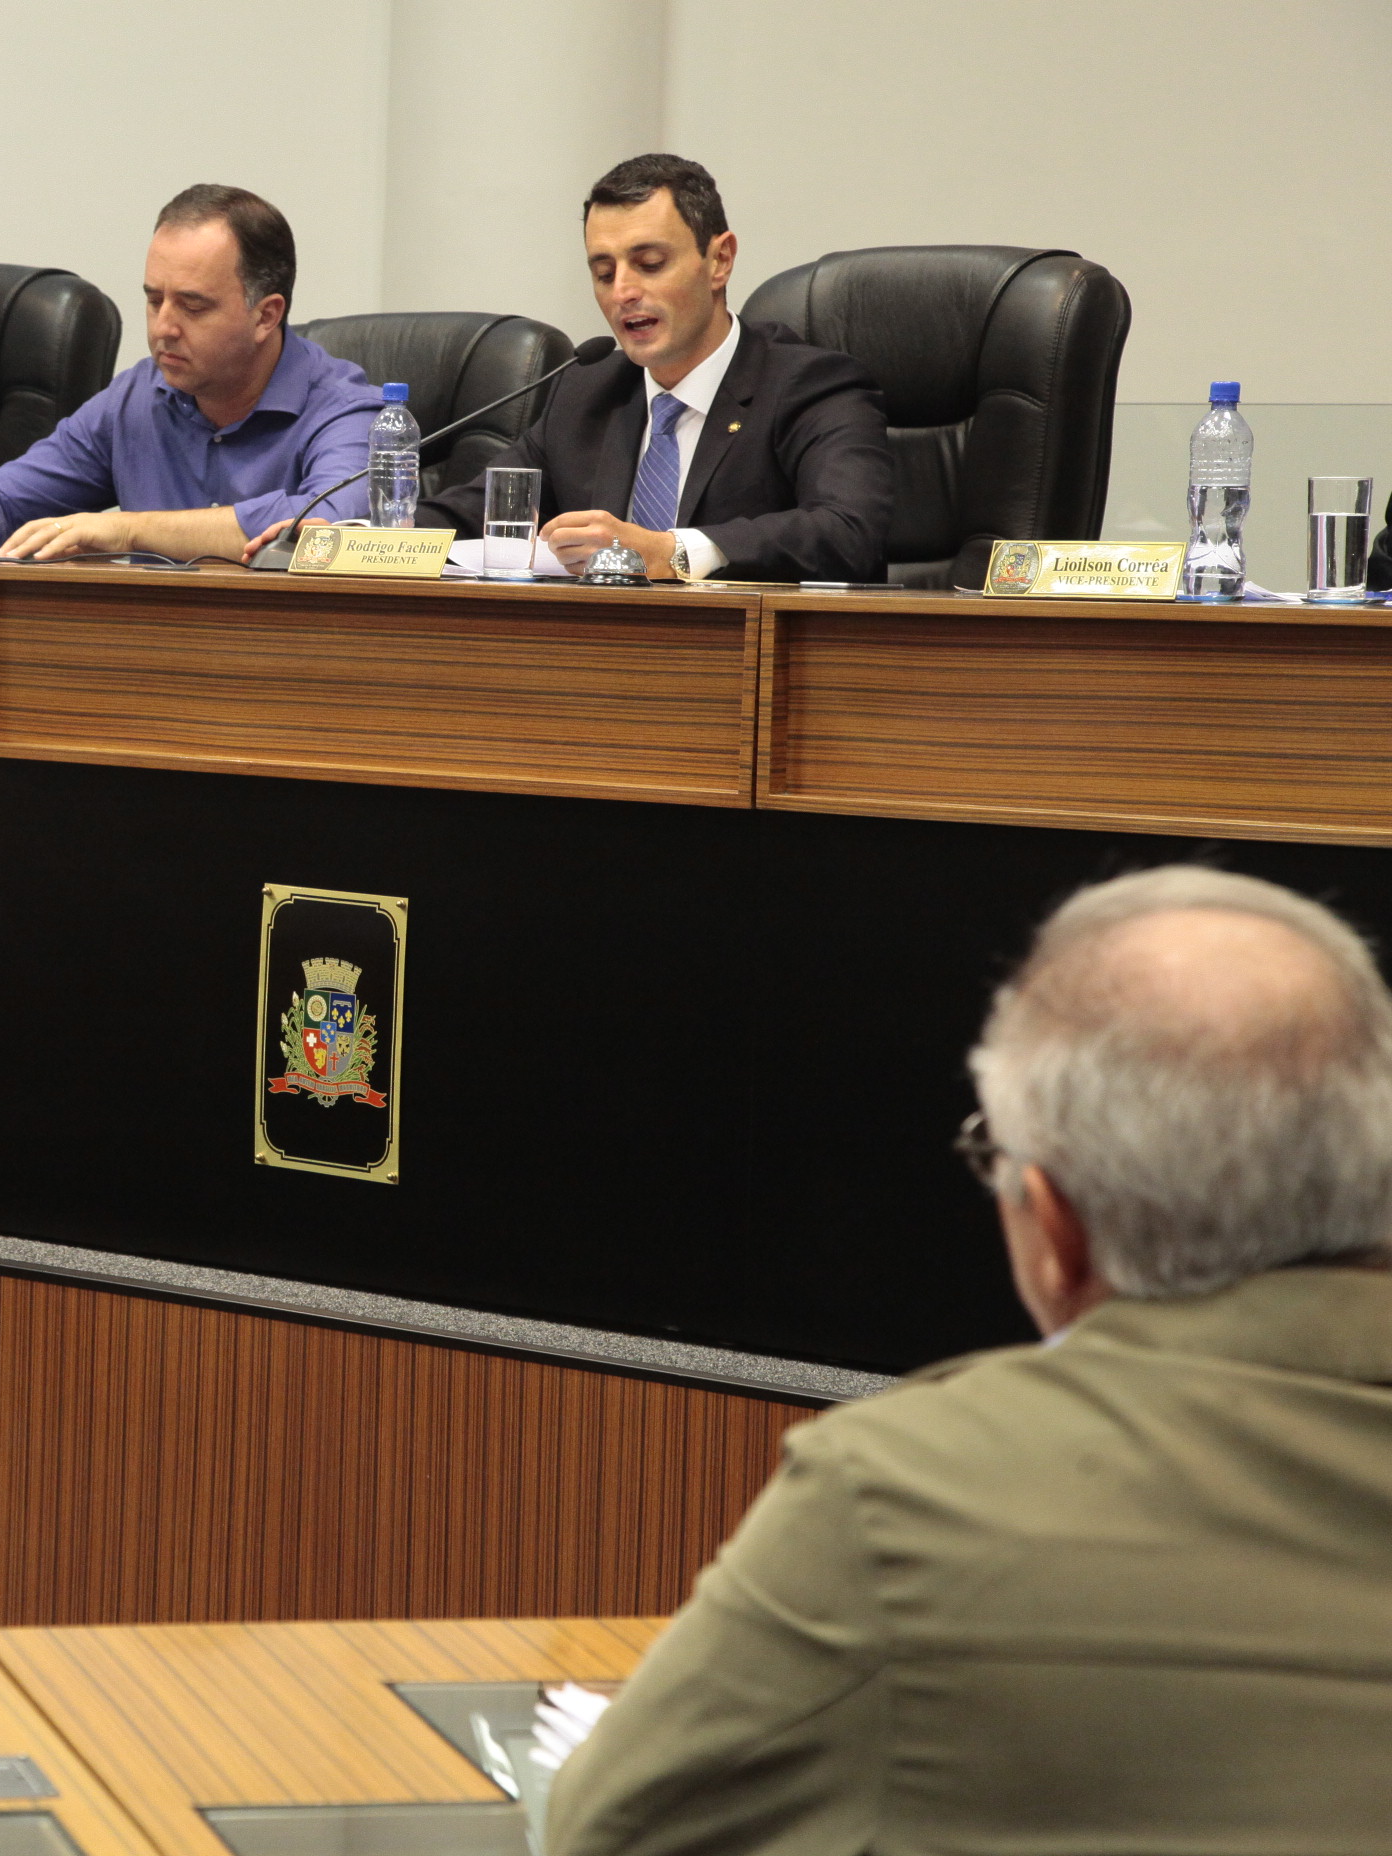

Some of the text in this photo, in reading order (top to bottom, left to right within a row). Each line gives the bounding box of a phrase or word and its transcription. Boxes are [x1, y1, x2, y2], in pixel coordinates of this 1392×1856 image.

[346, 539, 444, 555] Rodrigo Fachini
[361, 555, 418, 565] PRESIDENTE
[1053, 557, 1169, 573] Lioilson Corrêa
[1058, 575, 1159, 587] VICE-PRESIDENTE
